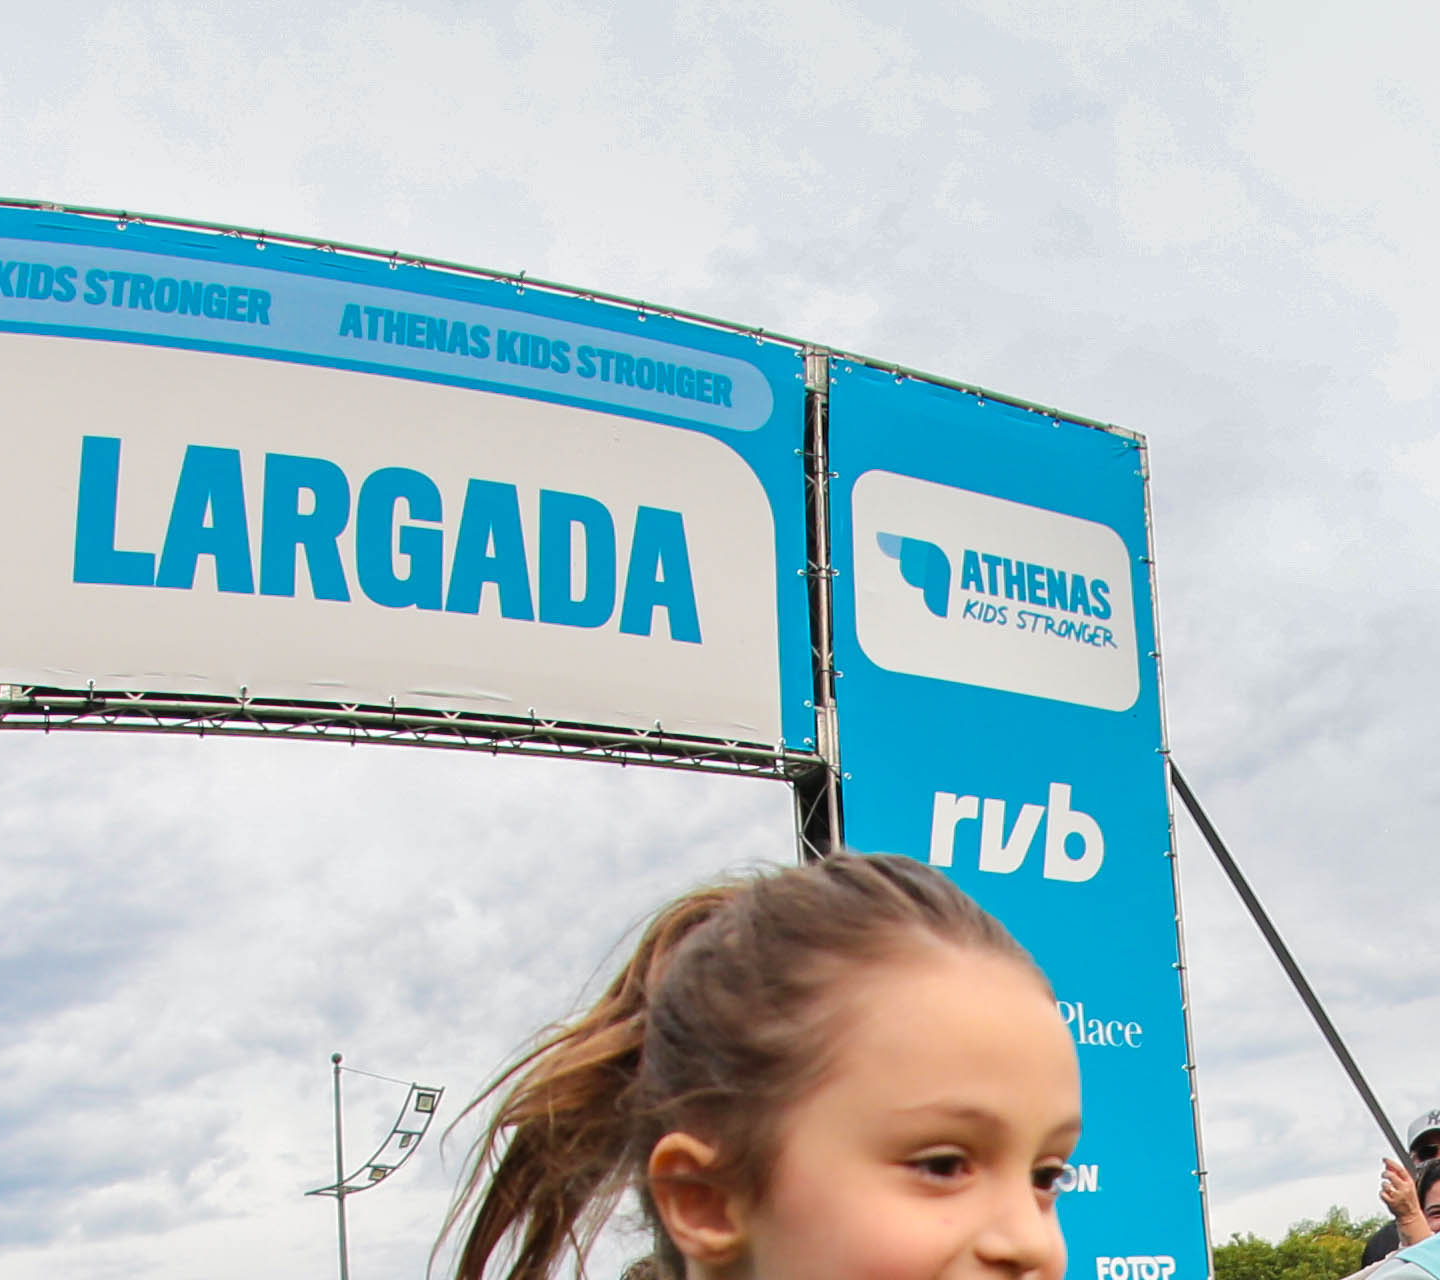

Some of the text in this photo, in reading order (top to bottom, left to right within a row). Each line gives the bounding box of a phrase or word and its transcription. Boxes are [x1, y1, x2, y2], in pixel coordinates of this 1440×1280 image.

[84, 269, 271, 325] STRONGER
[340, 304, 732, 407] ATHENAS KIDS STRONGER
[74, 435, 702, 644] LARGADA
[961, 550, 1111, 619] ATHENAS
[963, 599, 1117, 648] KIDS STRONGER
[929, 782, 1105, 882] rvb
